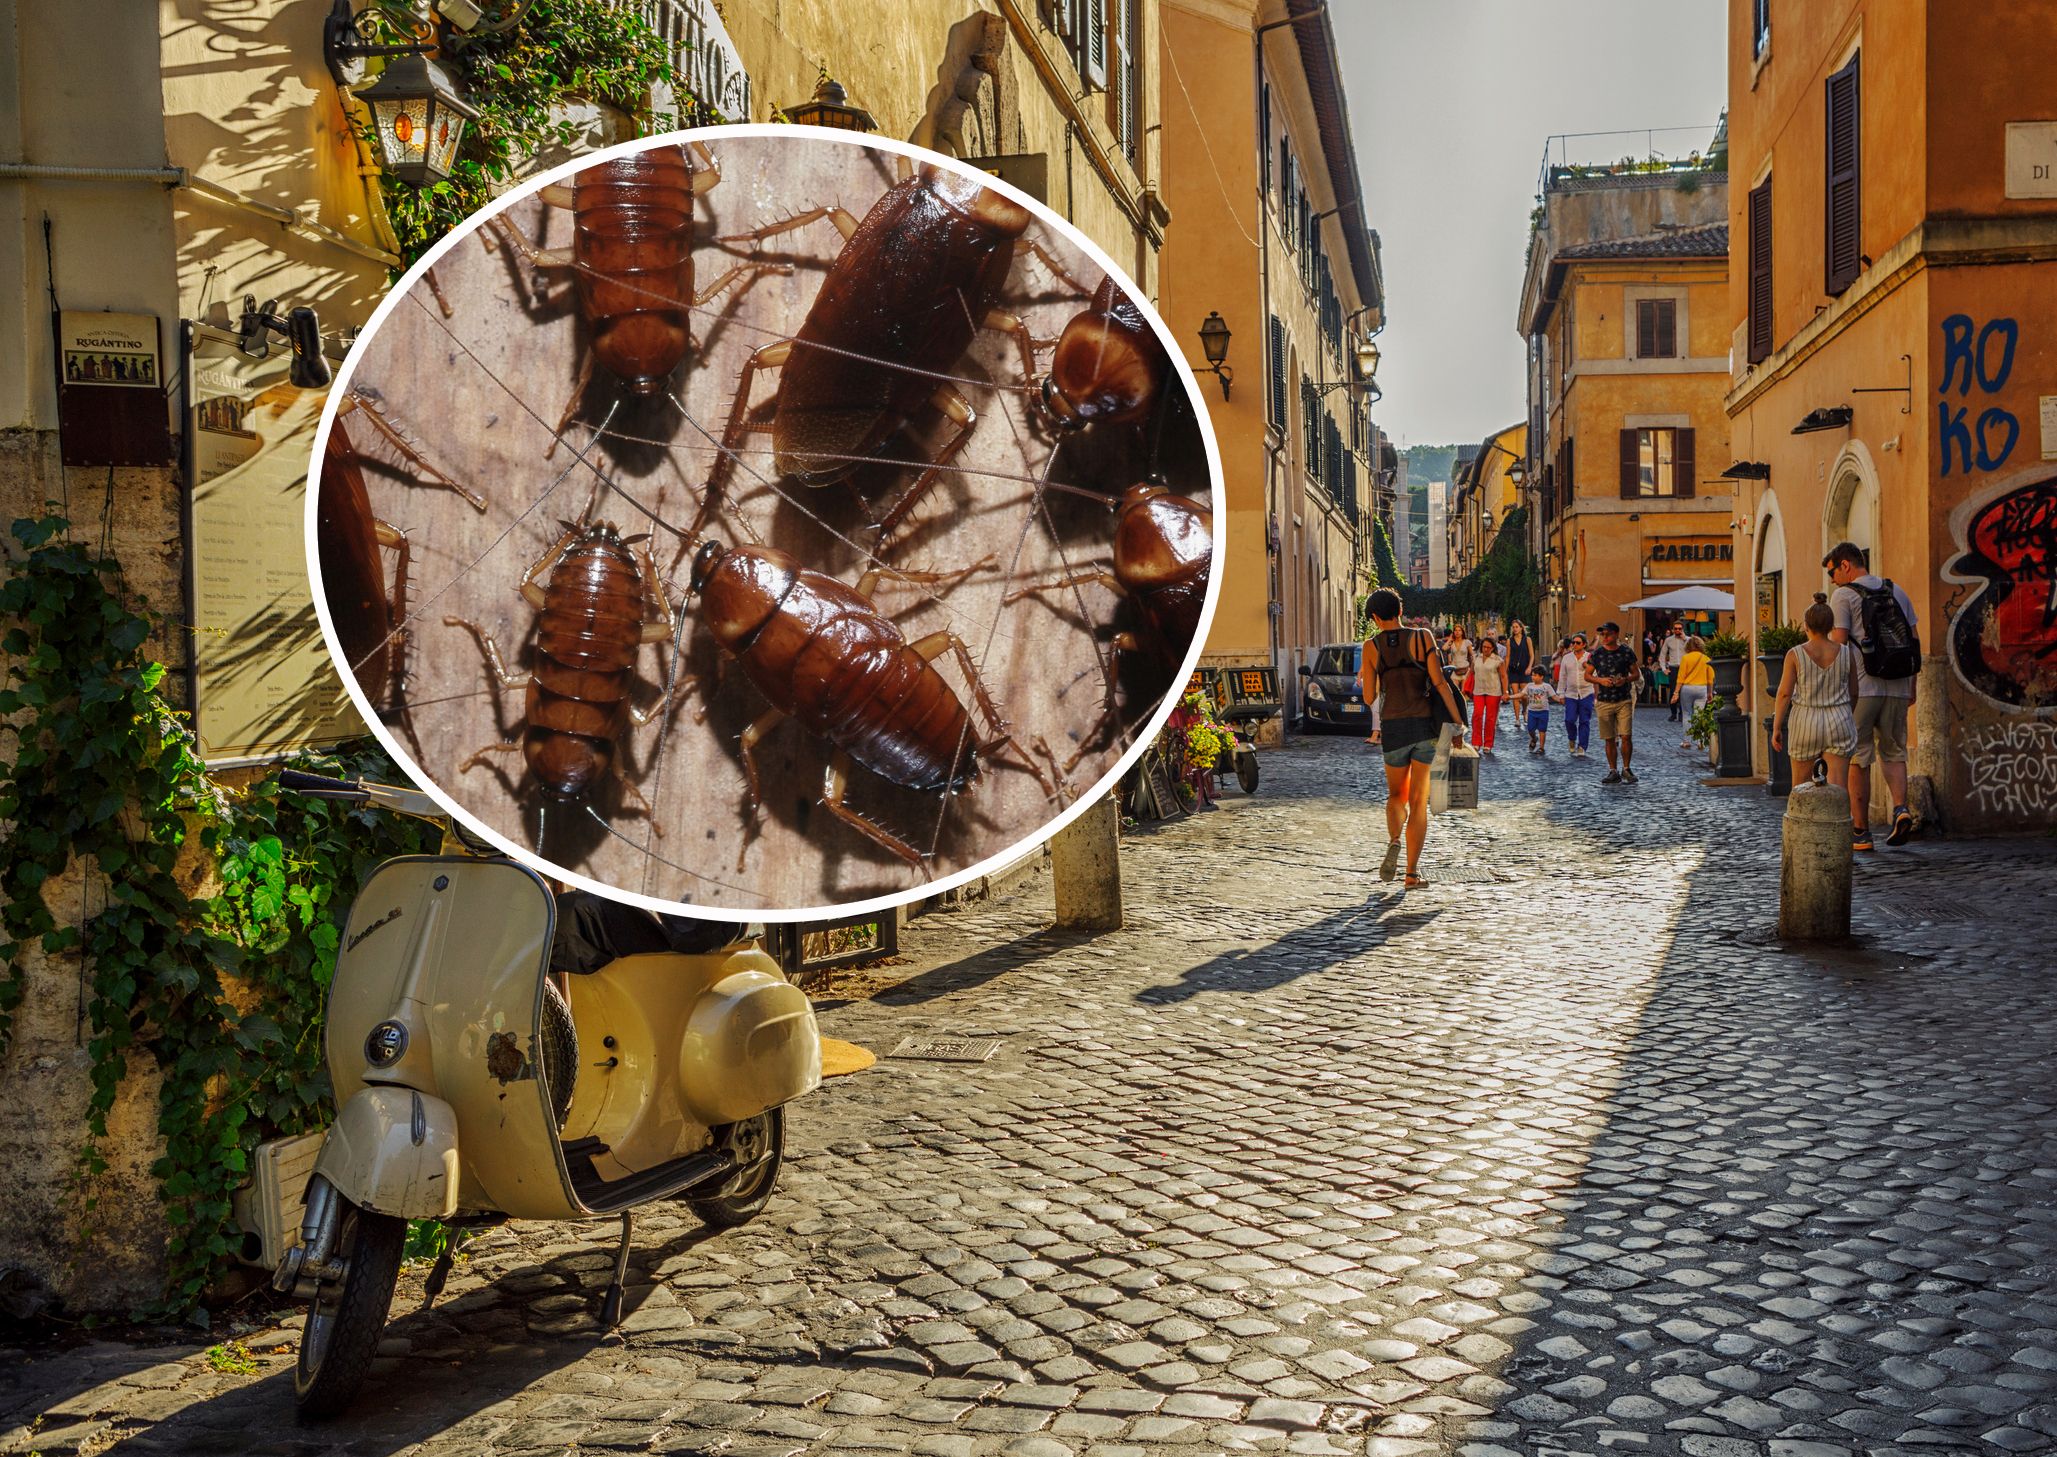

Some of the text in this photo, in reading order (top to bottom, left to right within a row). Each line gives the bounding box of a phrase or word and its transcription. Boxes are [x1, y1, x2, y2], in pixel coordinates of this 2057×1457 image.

[2033, 165, 2049, 179] DI
[76, 338, 143, 349] RUGANTINO
[1938, 401, 2020, 477] KO
[1652, 543, 1715, 561] CARLO
